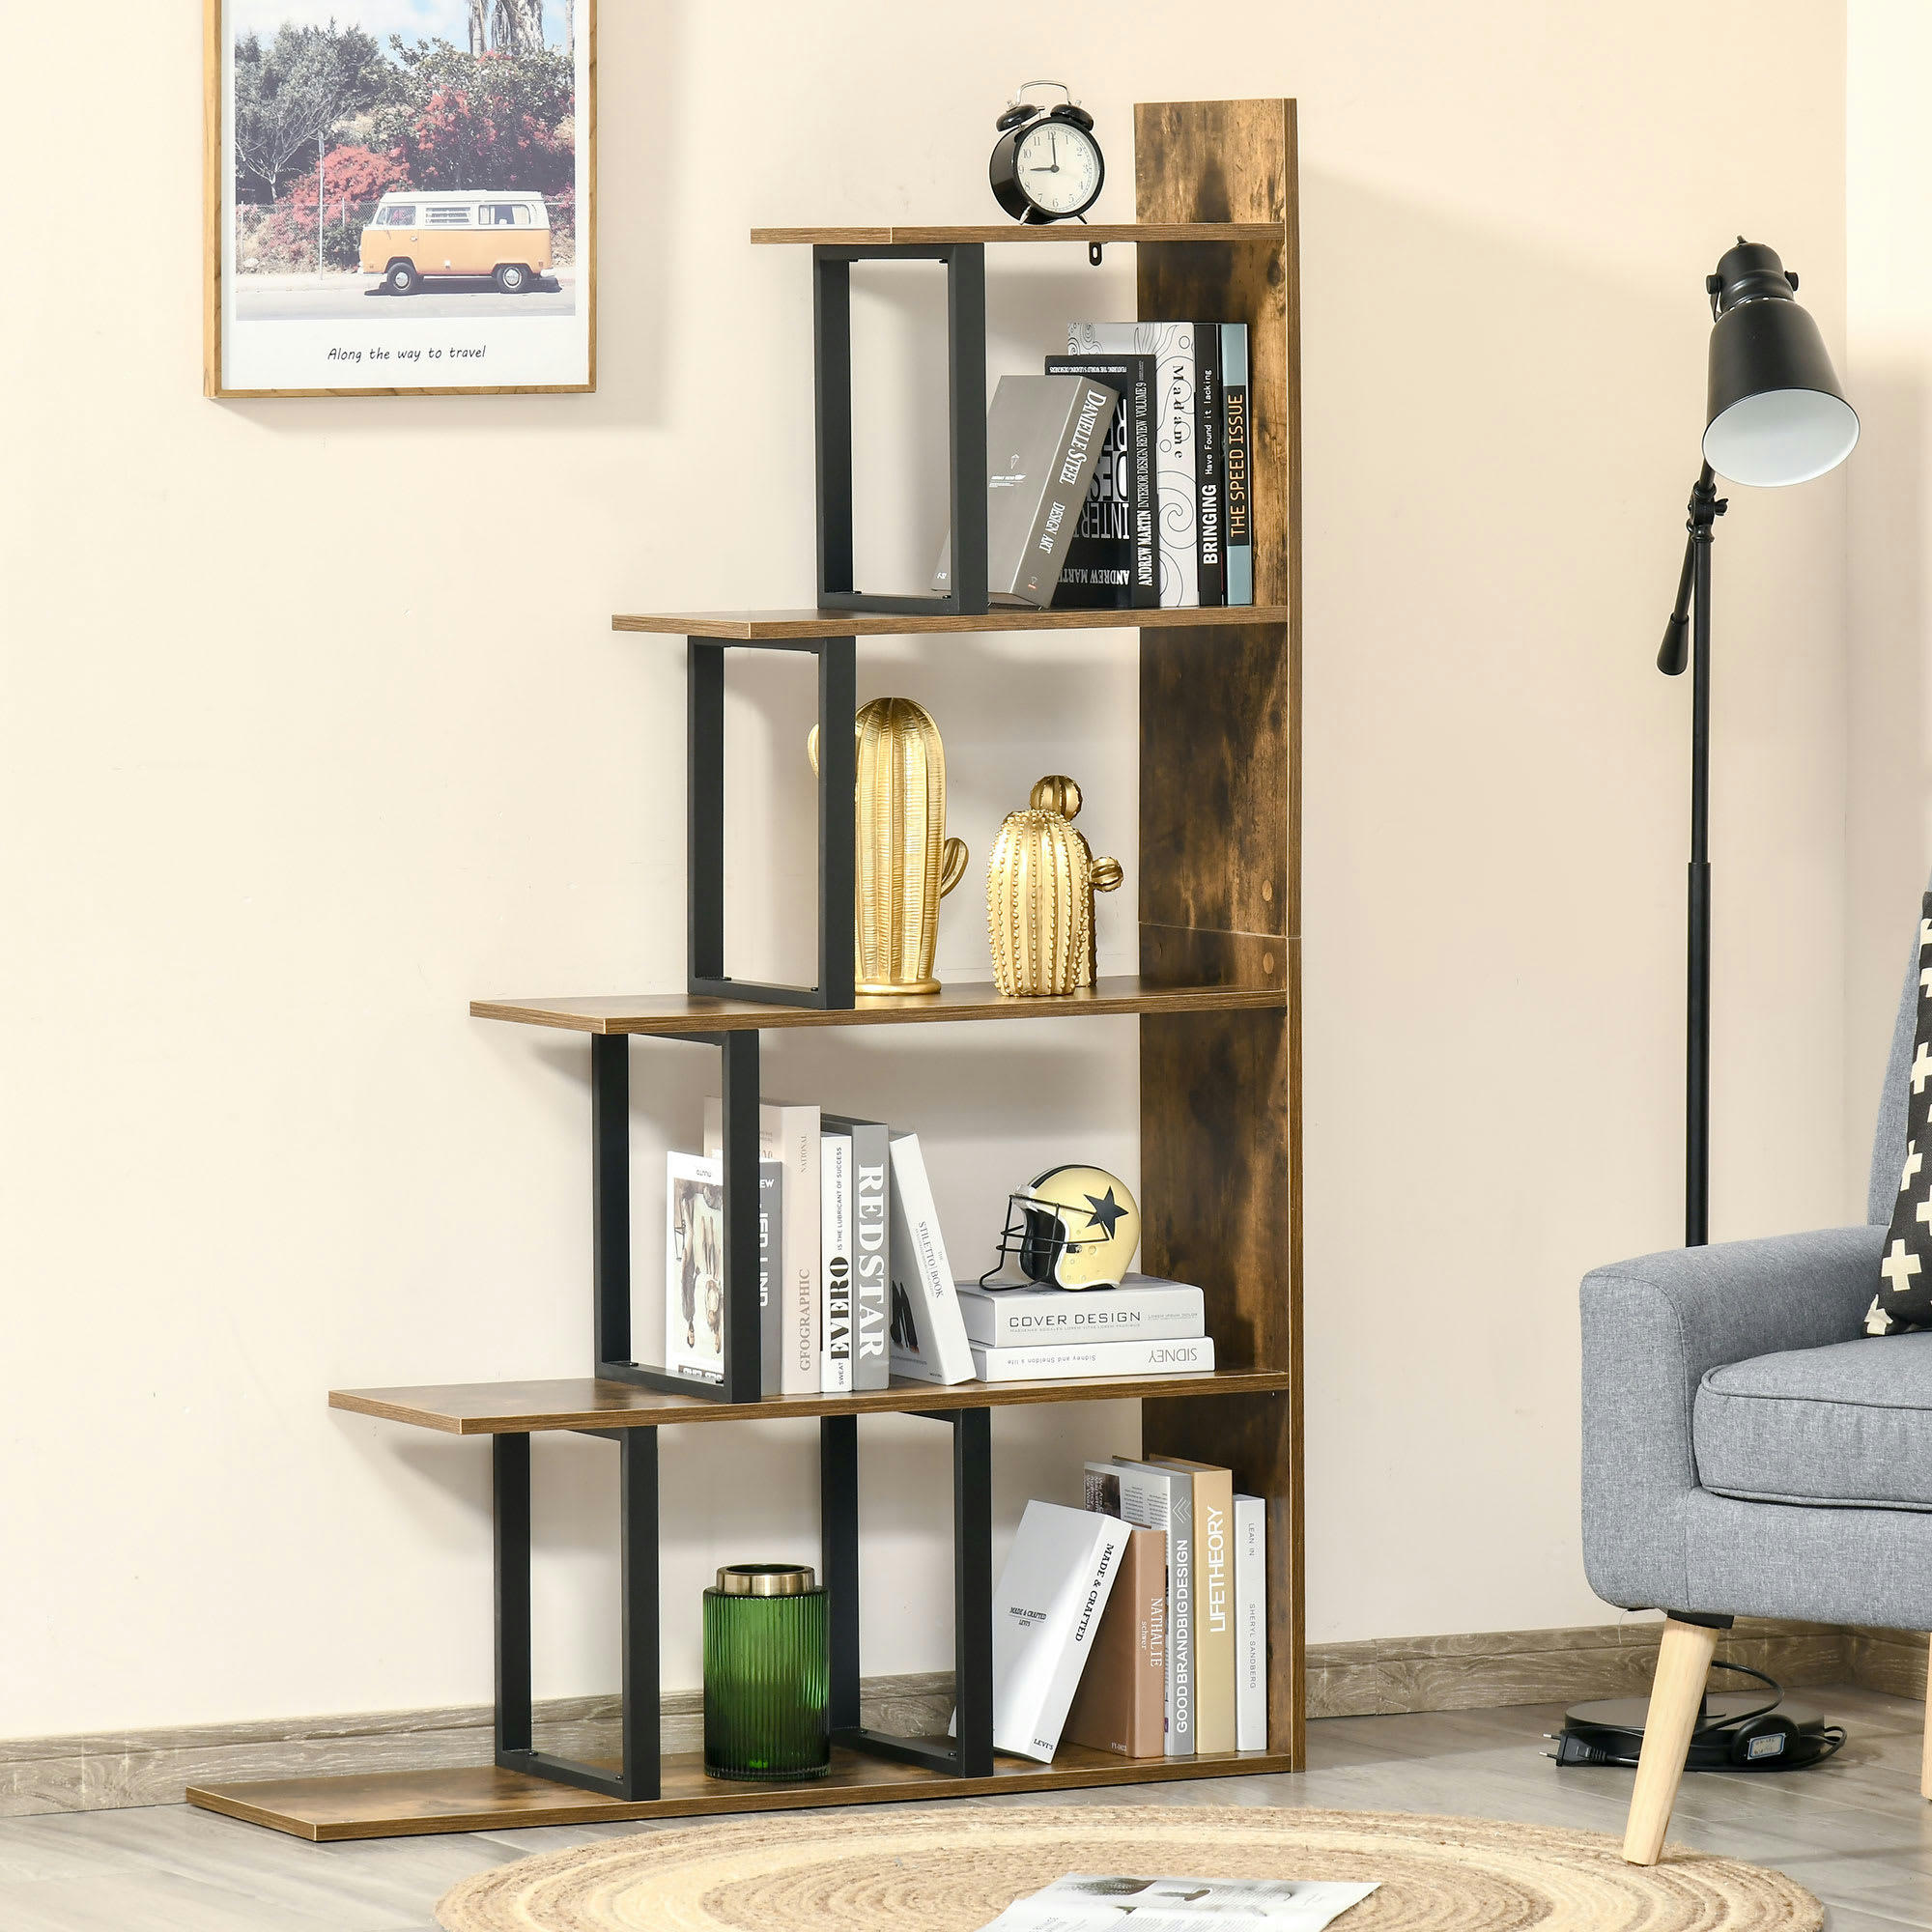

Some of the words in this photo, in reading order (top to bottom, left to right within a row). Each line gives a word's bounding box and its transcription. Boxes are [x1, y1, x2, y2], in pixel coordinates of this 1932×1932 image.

[1023, 149, 1032, 158] 10
[1034, 136, 1041, 146] 11
[1076, 147, 1083, 156] 2
[1018, 165, 1025, 174] 9
[1024, 182, 1031, 191] 8
[1037, 193, 1043, 203] 7
[1068, 193, 1074, 204] 5
[1052, 198, 1059, 207] 6
[327, 348, 362, 363] Along
[369, 347, 390, 359] the
[397, 349, 421, 362] way
[428, 348, 442, 358] to
[449, 345, 486, 357] travel
[1204, 369, 1212, 404] lacking
[1135, 387, 1148, 418] VOLUME
[1173, 364, 1184, 459] Madame
[1204, 410, 1211, 419] it
[1071, 389, 1107, 451] DANIELLE
[1136, 419, 1148, 447] REVIEW
[1228, 394, 1243, 444] ISSUE
[1059, 448, 1087, 485] STEEL
[1136, 447, 1149, 474] DESIGN
[1229, 449, 1245, 500] SPEED
[1137, 474, 1149, 508] INTERIOR
[1044, 501, 1065, 535] DESIGN
[1073, 502, 1130, 540] INTER
[1137, 510, 1151, 545] MARTIN
[1202, 484, 1218, 564] BRINGING
[1230, 505, 1245, 538] THE
[1038, 533, 1055, 554] ART
[1090, 569, 1130, 585] ANDREW
[1138, 548, 1152, 586] ANDREW
[837, 1180, 842, 1189] OF
[829, 1257, 849, 1360] EVERO
[1009, 1315, 1067, 1327] COVER
[1074, 1311, 1141, 1324] DESIGN
[1148, 1348, 1198, 1364] SIDNEY
[1097, 1543, 1115, 1577] MADE
[1075, 1590, 1098, 1642] CRAFTED
[1150, 1598, 1163, 1667] NATHALIE
